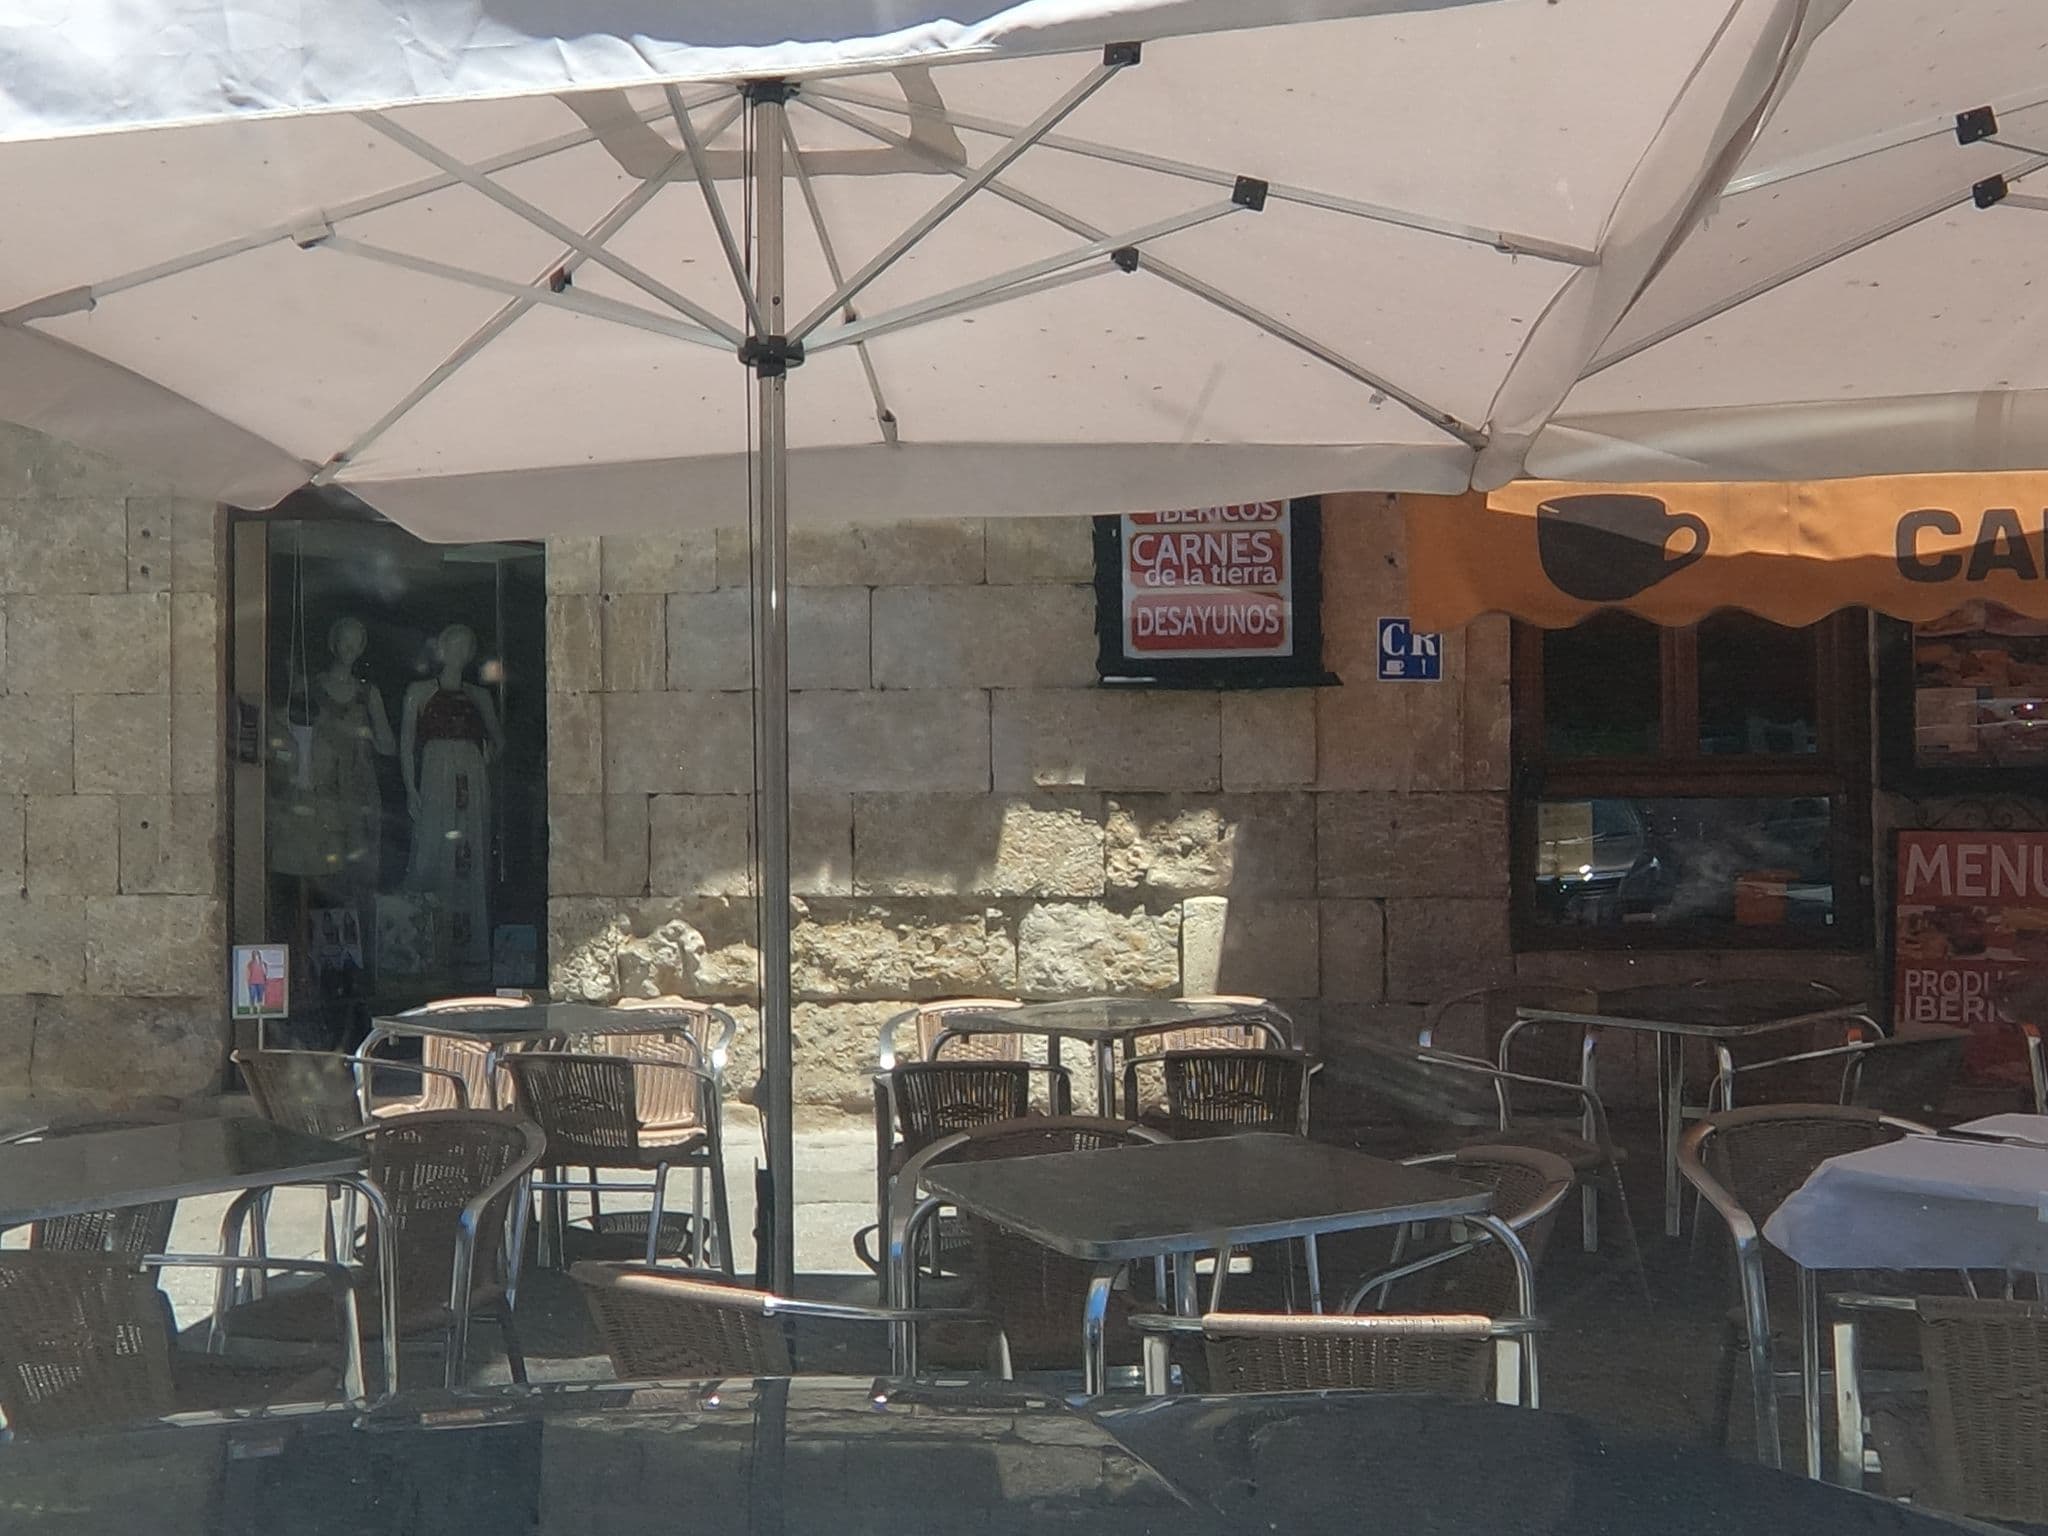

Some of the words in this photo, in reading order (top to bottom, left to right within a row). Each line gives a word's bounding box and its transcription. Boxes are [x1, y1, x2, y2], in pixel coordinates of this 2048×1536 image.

[1132, 530, 1273, 567] CARNES
[1896, 508, 2048, 583] CA
[1144, 561, 1176, 586] de
[1183, 560, 1205, 586] la
[1210, 564, 1279, 586] tierra
[1136, 603, 1280, 637] DESAYUNOS
